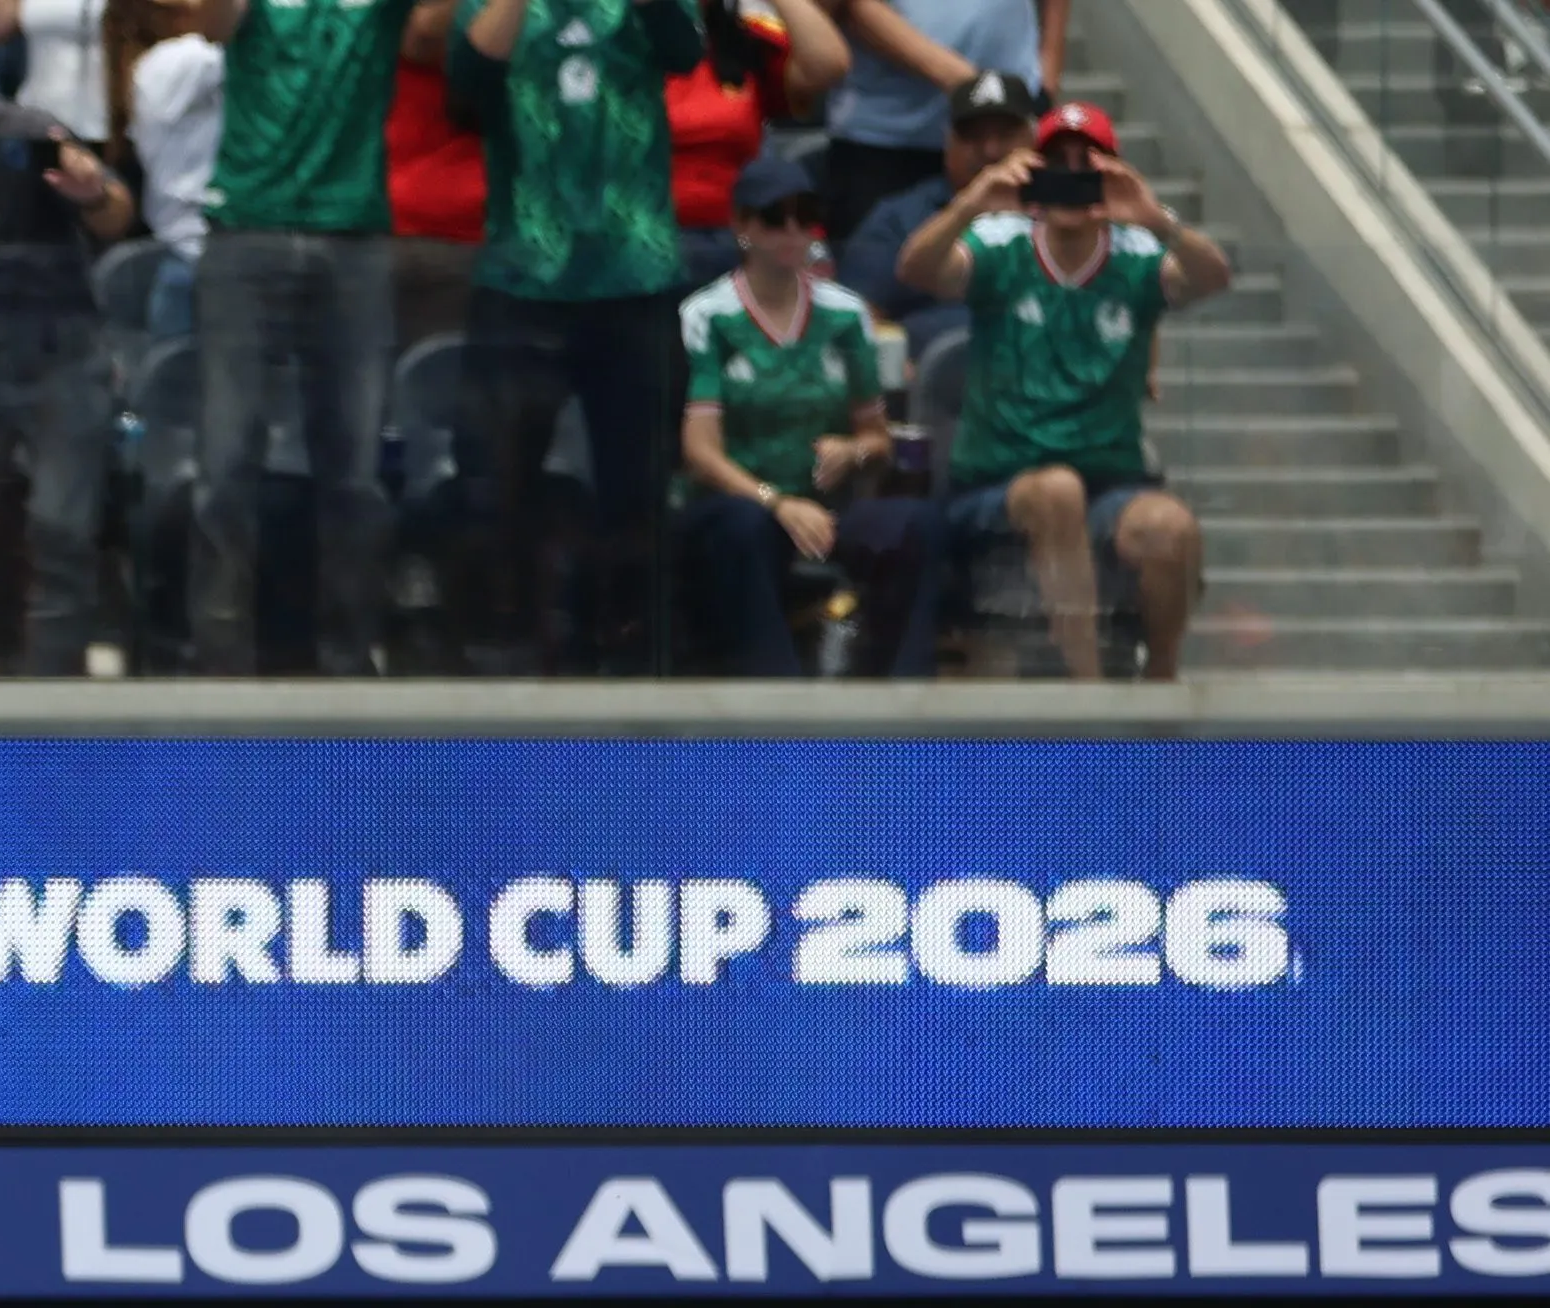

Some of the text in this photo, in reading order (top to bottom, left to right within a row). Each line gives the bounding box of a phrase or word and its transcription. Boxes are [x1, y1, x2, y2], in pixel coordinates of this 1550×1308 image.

[489, 873, 772, 991] CUP
[791, 876, 1289, 992] 2026
[59, 1170, 1550, 1284] LOS ANGELES
